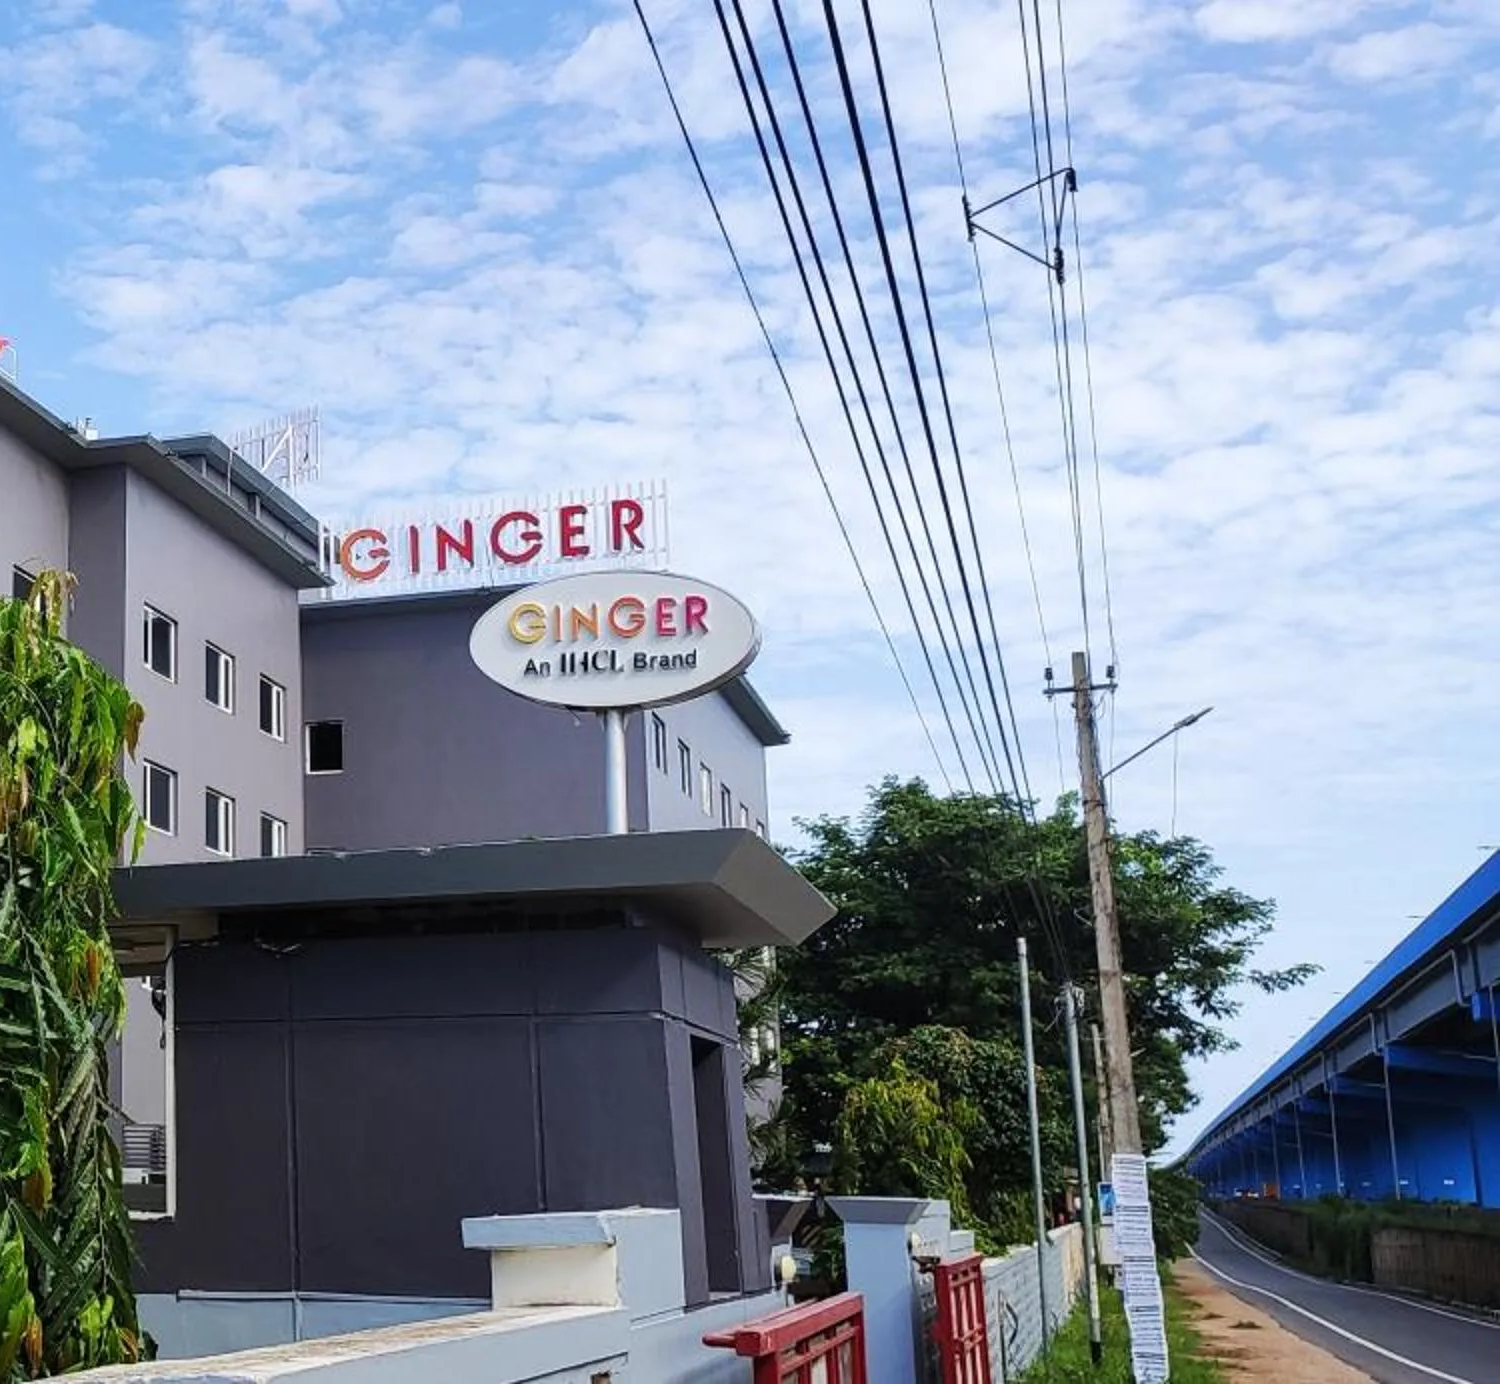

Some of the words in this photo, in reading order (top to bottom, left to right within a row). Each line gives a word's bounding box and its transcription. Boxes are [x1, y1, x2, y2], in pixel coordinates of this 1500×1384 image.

[339, 499, 645, 581] GINGER
[510, 596, 708, 644] GINGER
[524, 658, 550, 676] An
[561, 650, 624, 675] IHCL
[633, 649, 697, 669] Brand
